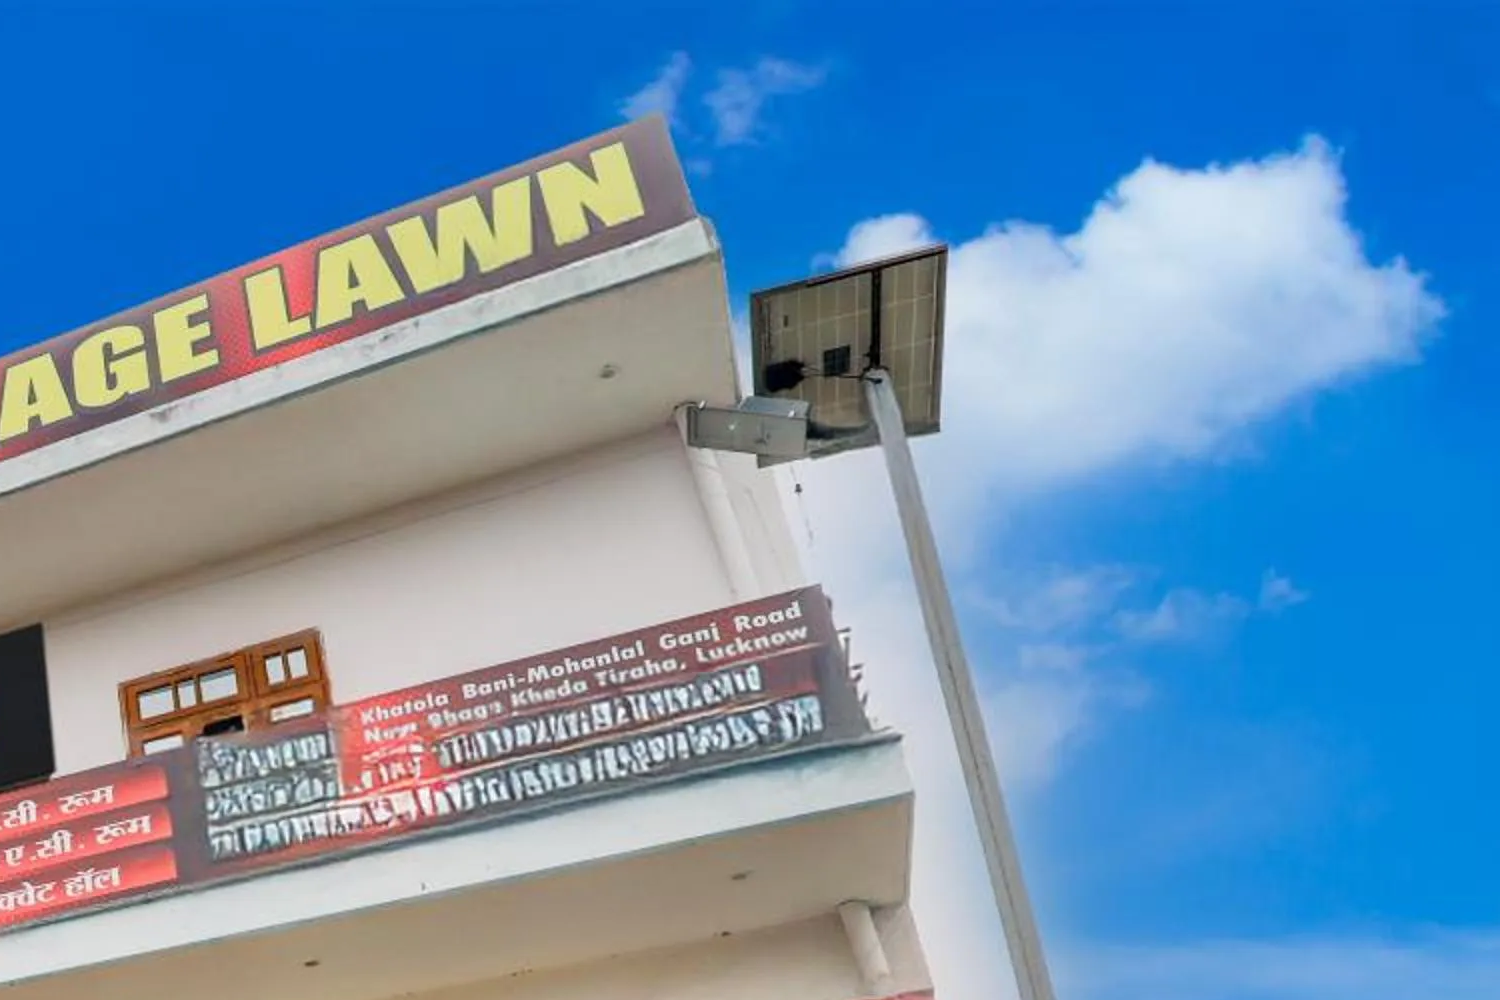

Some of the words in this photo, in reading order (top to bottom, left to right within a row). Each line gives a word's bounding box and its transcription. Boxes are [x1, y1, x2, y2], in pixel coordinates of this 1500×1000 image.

[242, 141, 646, 351] LAWN
[462, 640, 646, 699] Bani-Mohanlal
[659, 622, 721, 650] Ganj
[733, 602, 802, 633] Road
[511, 678, 588, 708] Kheda
[595, 657, 687, 687] Tiraha,
[695, 625, 808, 663] Lucknow
[58, 784, 115, 815] रूम
[94, 814, 152, 845] रूम
[63, 865, 122, 897] हॉल
